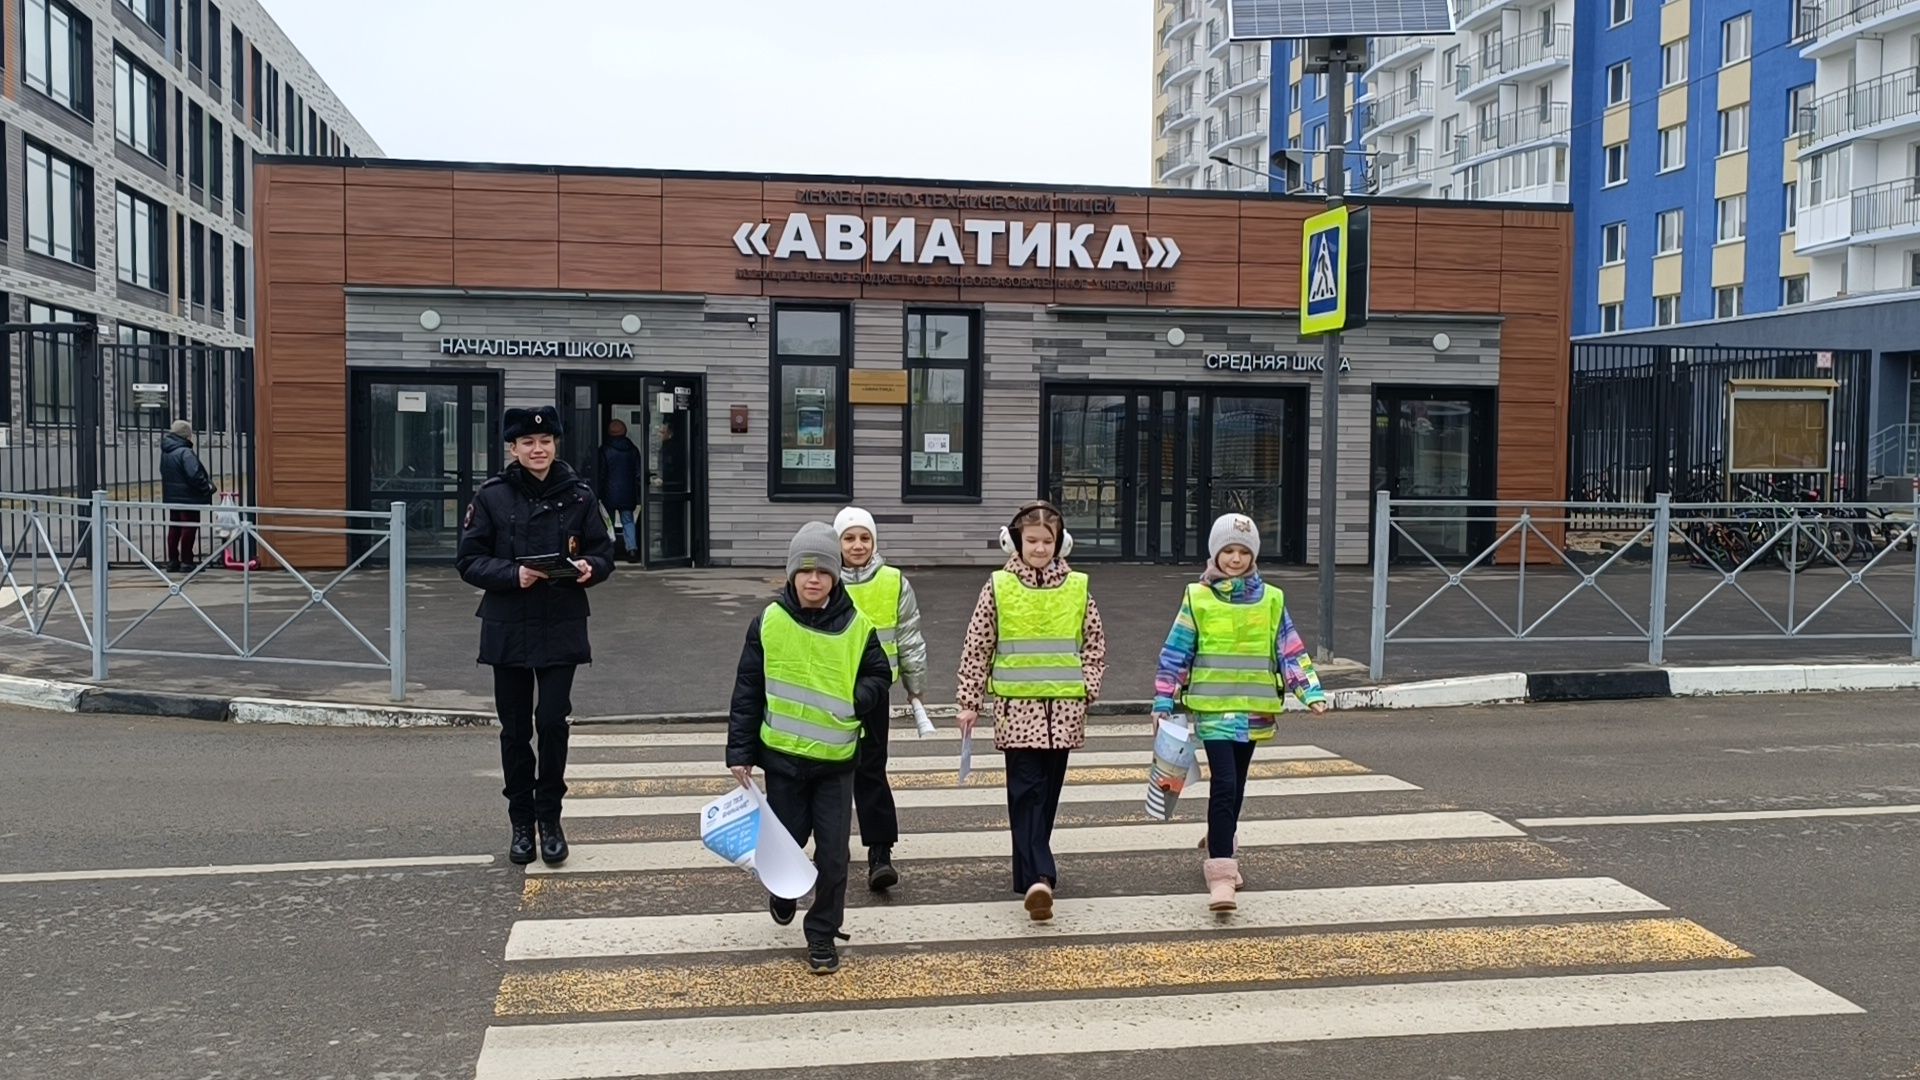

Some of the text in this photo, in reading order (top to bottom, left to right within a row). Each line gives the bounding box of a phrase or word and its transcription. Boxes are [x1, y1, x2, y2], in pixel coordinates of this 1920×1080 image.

[1056, 195, 1116, 214] ЛИЦЕЙ
[732, 212, 1182, 270] «АВИАТИКА»
[440, 338, 634, 359] НАЧАЛЬНАЯ ШКОЛА
[1206, 354, 1351, 372] СРЕДНЯЯ ШКОА
